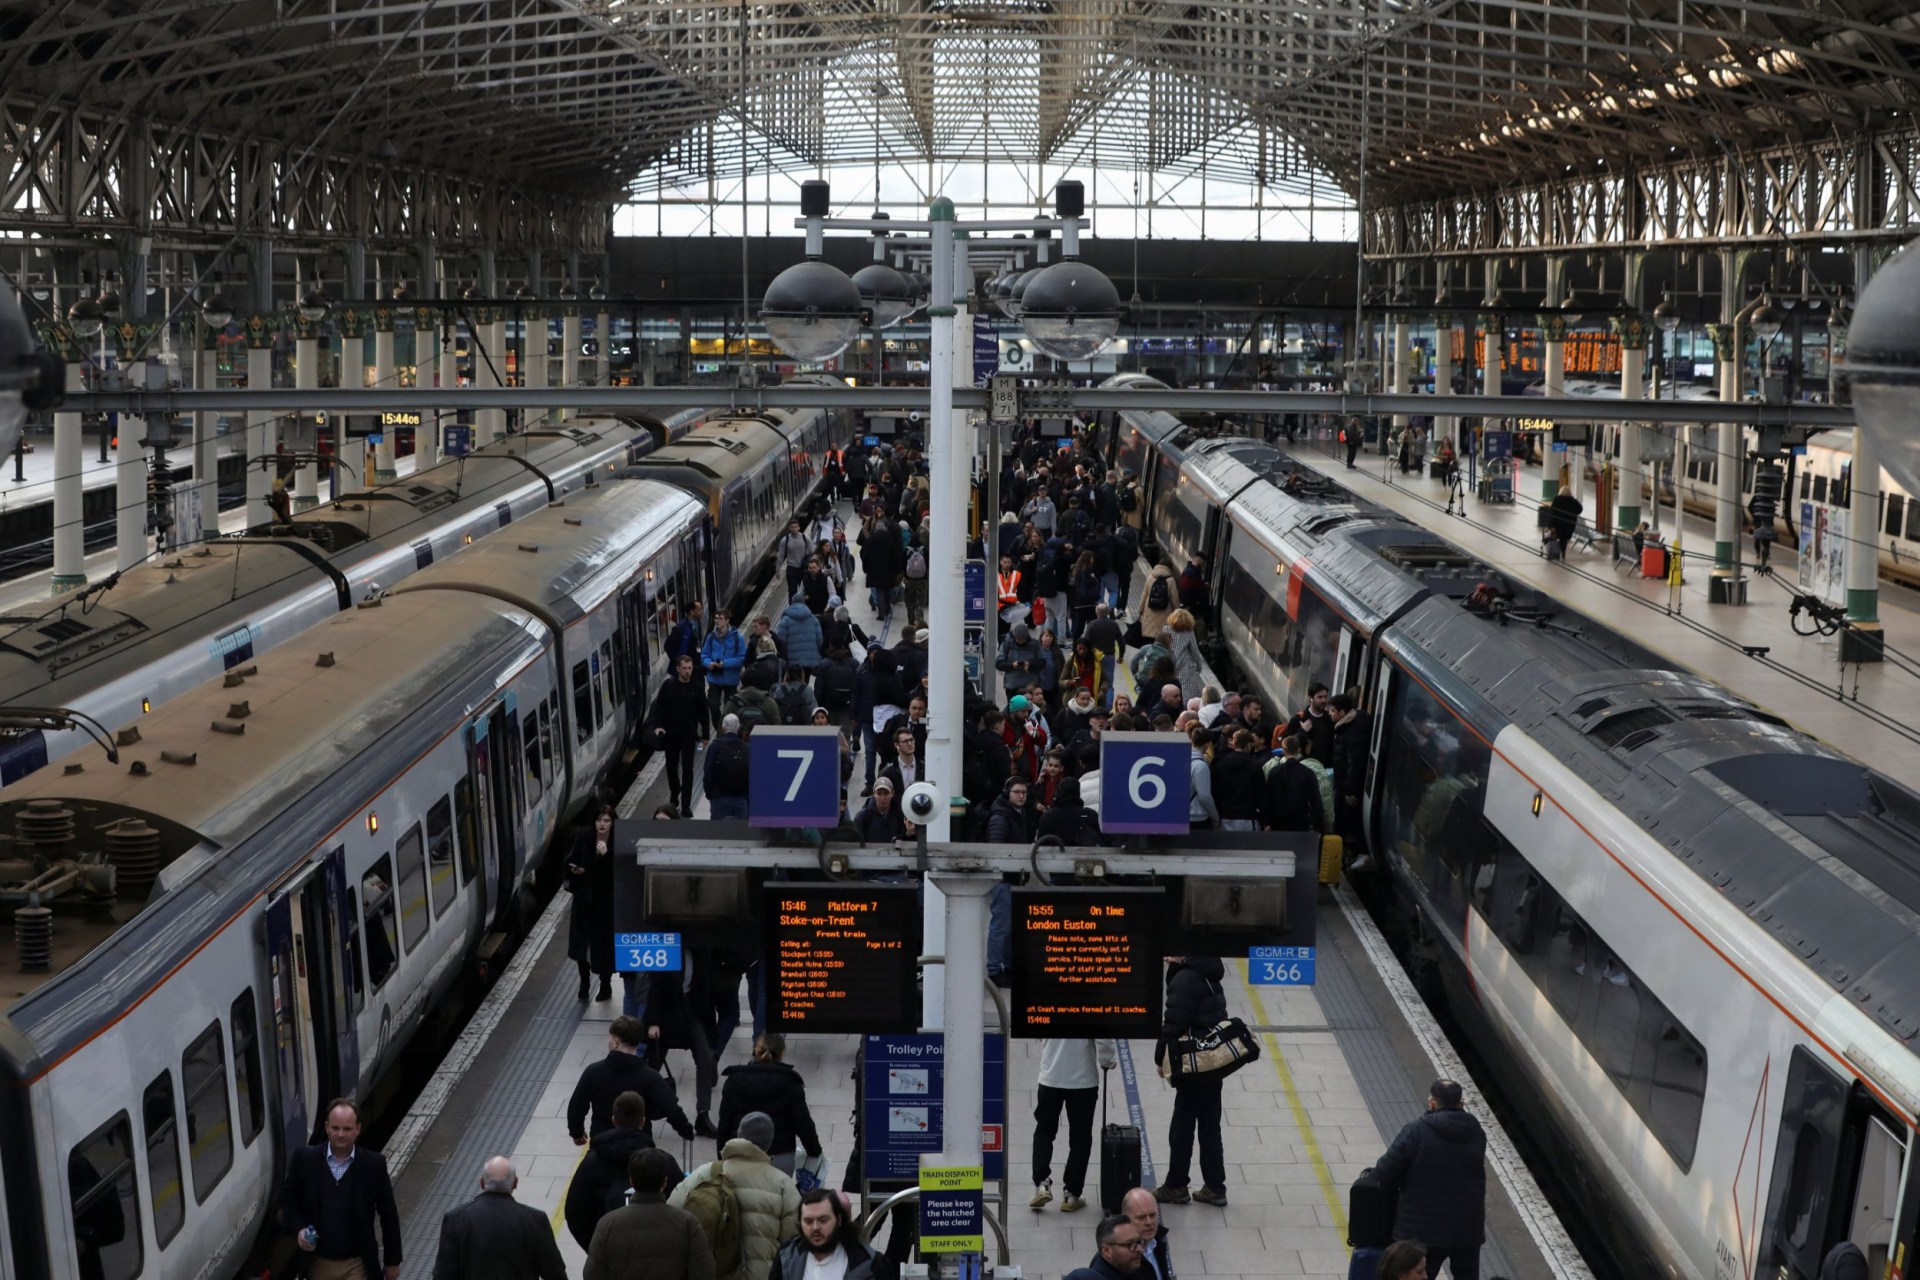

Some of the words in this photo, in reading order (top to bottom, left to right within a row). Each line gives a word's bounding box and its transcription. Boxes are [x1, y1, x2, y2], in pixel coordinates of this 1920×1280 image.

[1000, 380, 1008, 388] M
[996, 392, 1013, 402] 188
[1000, 406, 1011, 414] 71
[777, 750, 814, 801] 7
[1128, 756, 1166, 809] 6
[782, 901, 806, 910] 15:46
[828, 902, 867, 911] Platform
[872, 902, 877, 911] 7
[1029, 906, 1053, 915] 15:55
[1090, 906, 1102, 915] On
[1106, 906, 1124, 915] time
[781, 915, 854, 925] Stoke-on-Trent
[1027, 920, 1060, 929] London
[1064, 920, 1096, 929] Euston
[621, 934, 660, 944] GSM-R
[781, 941, 800, 949] Calling
[867, 941, 881, 949] Page
[1255, 947, 1295, 957] GSM-R
[629, 949, 668, 968] 368
[1263, 962, 1302, 981] 366
[886, 1044, 923, 1057] Trolley
[926, 1044, 944, 1055] Poi
[955, 1200, 974, 1209] keep
[927, 1209, 940, 1217] the
[942, 1209, 975, 1217] hatched
[951, 1218, 971, 1226] clear
[930, 1240, 951, 1248] STAFF
[1716, 1237, 1738, 1278] AVANTI
